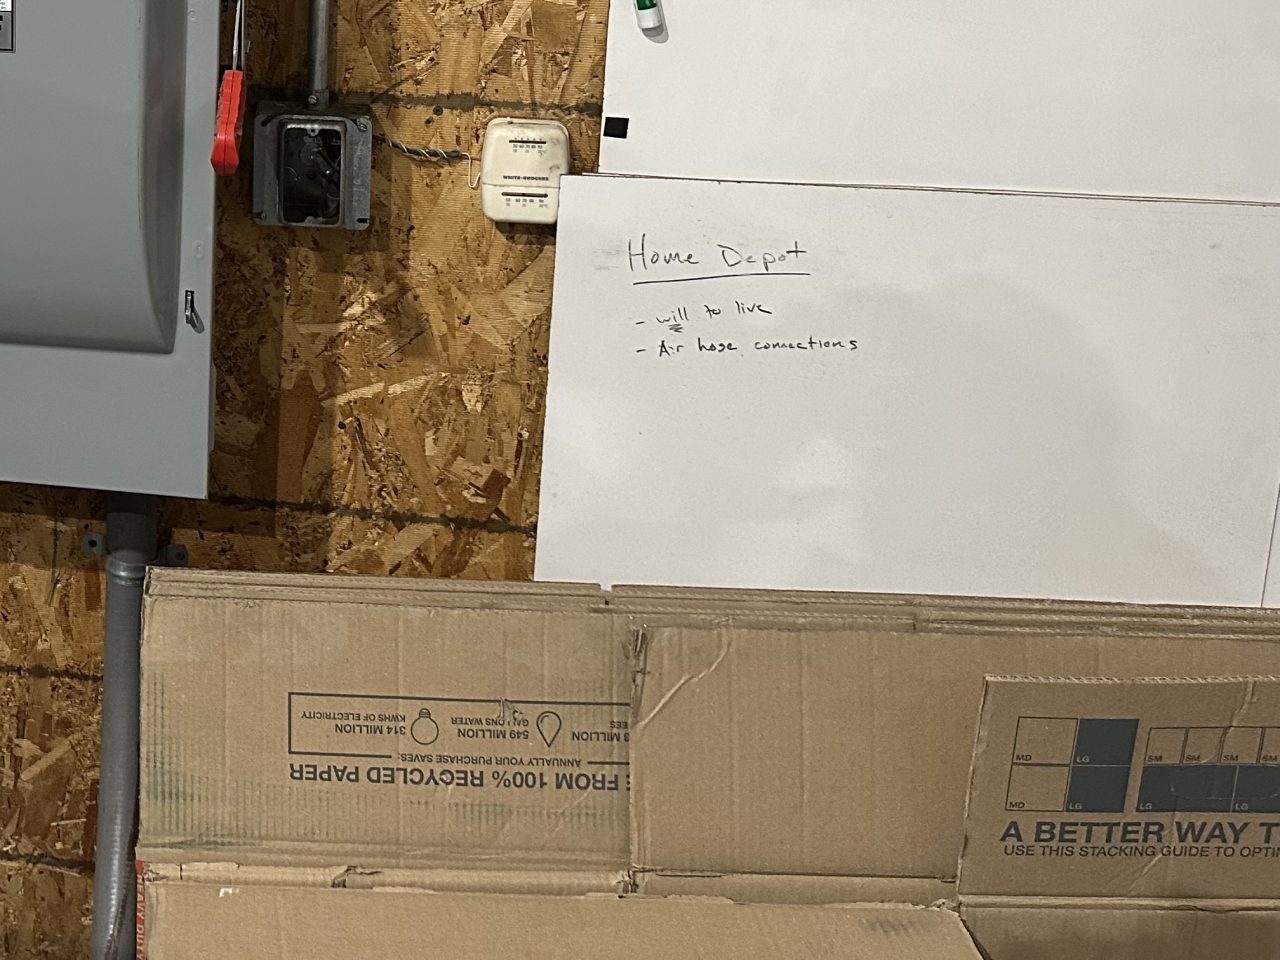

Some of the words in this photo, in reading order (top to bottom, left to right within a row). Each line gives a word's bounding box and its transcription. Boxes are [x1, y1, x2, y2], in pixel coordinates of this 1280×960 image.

[627, 233, 700, 271] Home
[717, 241, 807, 272] Depot
[656, 307, 689, 323] will
[704, 304, 721, 318] to
[735, 301, 773, 315] live
[659, 339, 684, 357] Air
[697, 337, 738, 353] hose
[754, 334, 859, 351] connections
[301, 711, 361, 721] ELECTRICITY
[363, 713, 376, 721] OF
[378, 714, 406, 722] KWHS
[451, 716, 483, 725] WATER
[335, 723, 384, 735] MILLION
[386, 725, 406, 735] 314
[457, 728, 507, 739] MILLION
[509, 730, 529, 739] 549
[572, 731, 621, 742] MILLION
[397, 752, 433, 763] SAVES:
[436, 754, 492, 765] PURCHASE
[495, 756, 524, 766] YOUR
[528, 757, 582, 767] ANNUALLY
[1076, 755, 1090, 763] LG
[1147, 754, 1163, 762] SM
[289, 763, 360, 783] PAPER
[366, 766, 484, 788] RECYCLED
[492, 770, 548, 789] 100%
[555, 772, 619, 791] FROM
[1008, 801, 1025, 809] MD
[1069, 802, 1082, 810] LG
[1140, 802, 1153, 810] LG
[999, 820, 1023, 842] A
[1034, 821, 1165, 843] BETTER
[1175, 821, 1250, 844] WAY
[1004, 845, 1036, 856] USE
[1039, 845, 1075, 857] THIS
[1078, 845, 1156, 857] STACKING
[1161, 845, 1210, 857] GUIDE
[1214, 846, 1235, 858] TO
[136, 873, 145, 920] HEAVY
